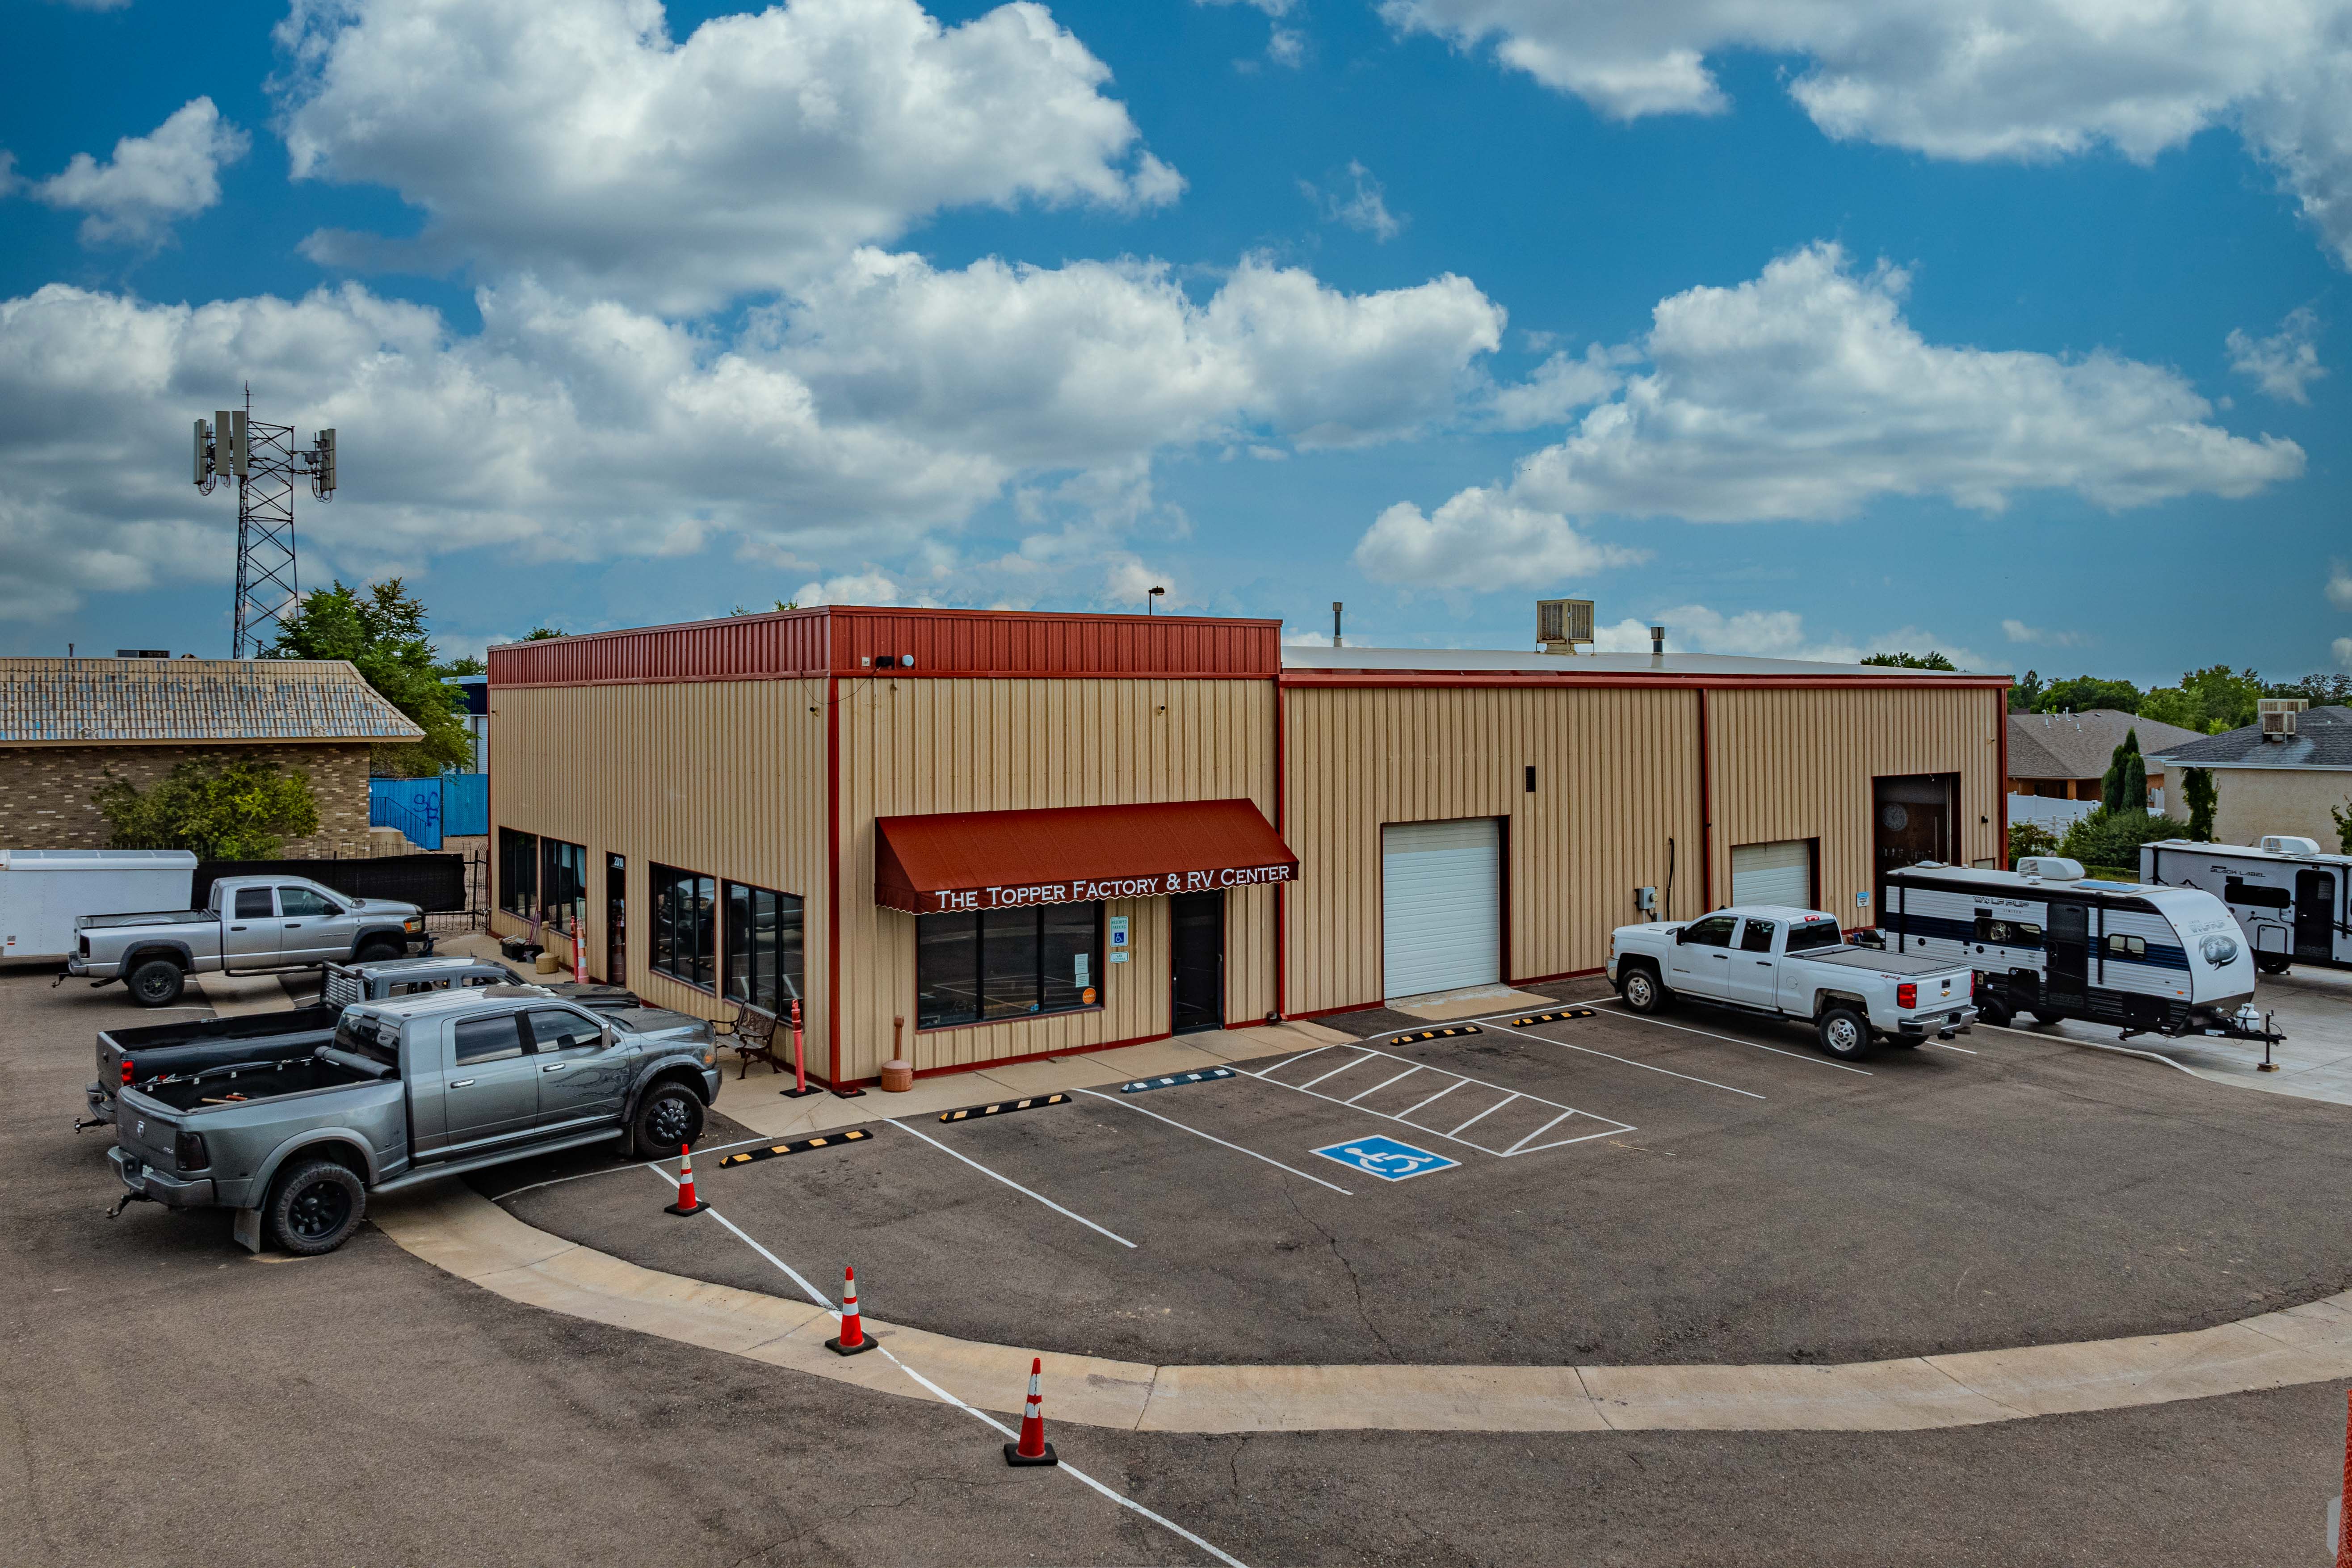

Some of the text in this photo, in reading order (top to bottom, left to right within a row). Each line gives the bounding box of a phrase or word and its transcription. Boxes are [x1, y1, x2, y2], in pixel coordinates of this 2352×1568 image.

[614, 857, 624, 867] 2010
[936, 866, 1289, 908] THE TOPPER FACTORY & RV CENTER
[2005, 900, 2029, 908] PUP
